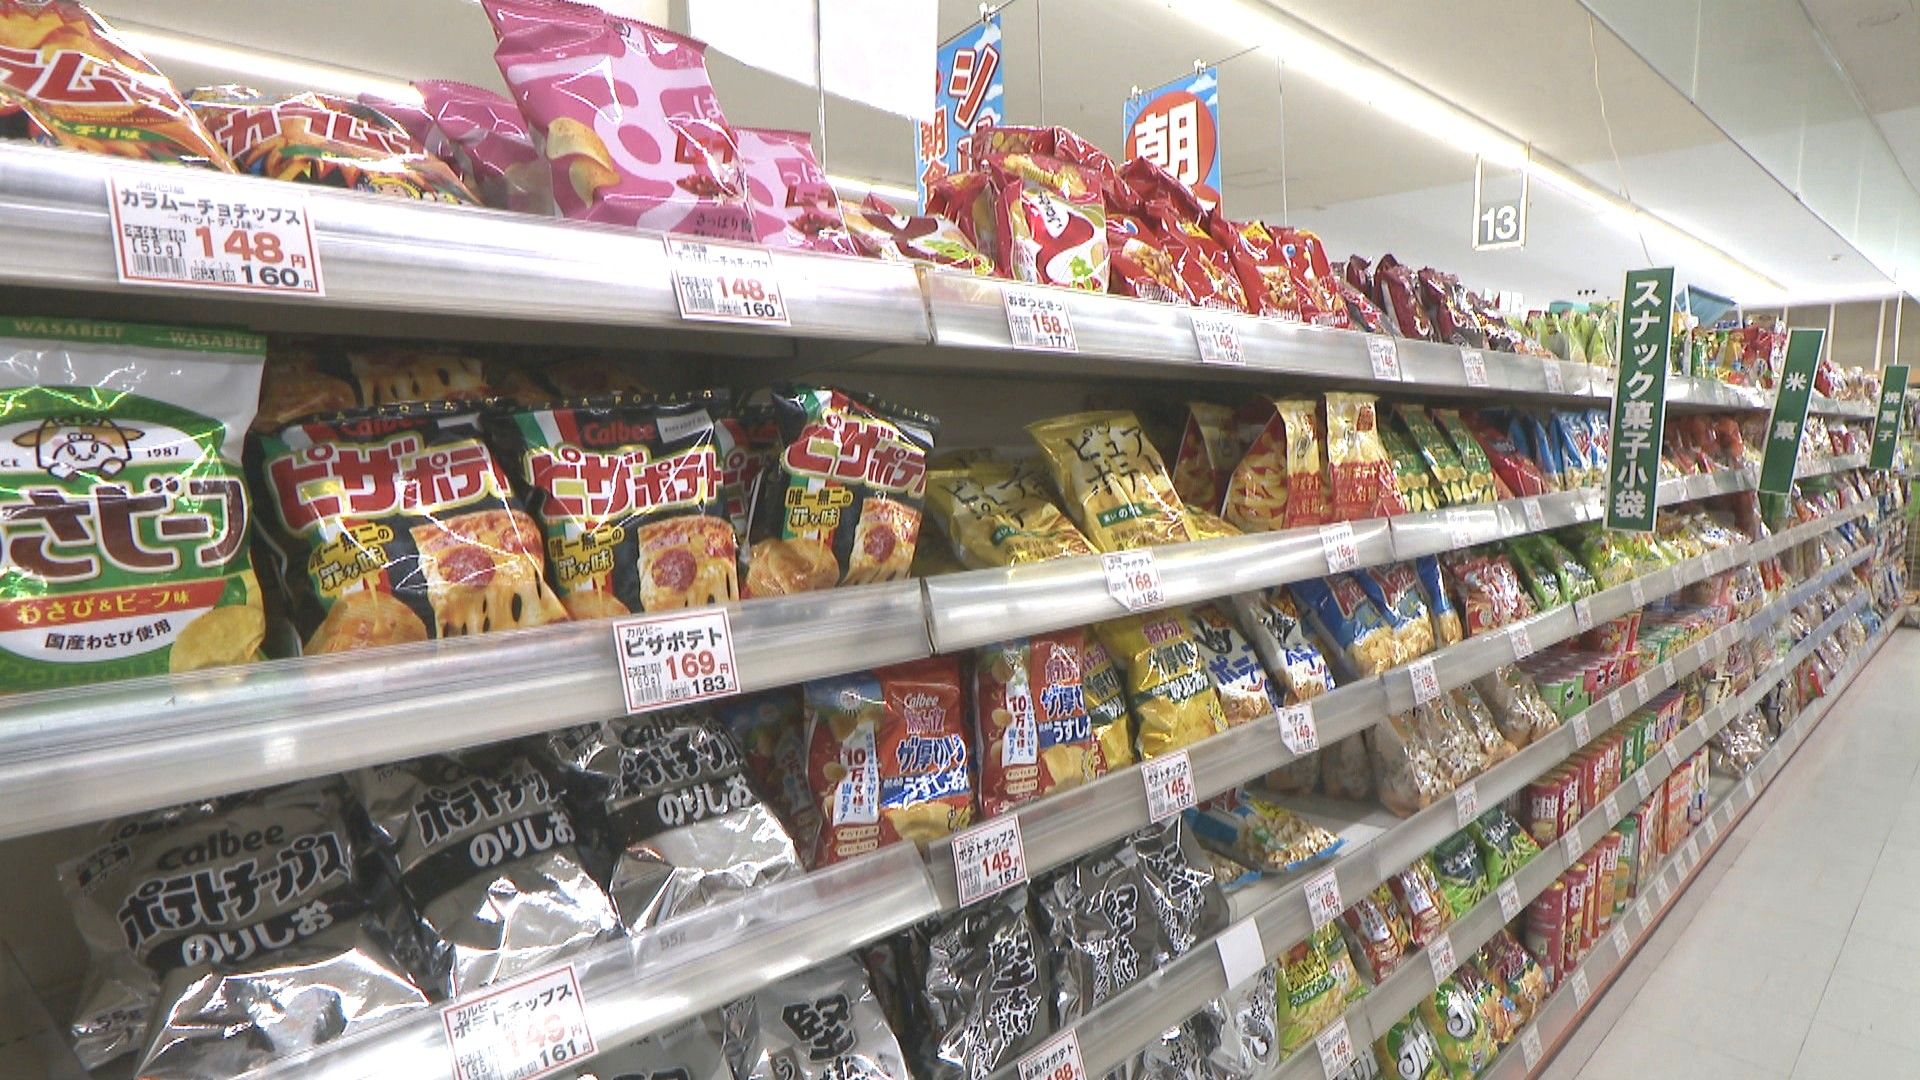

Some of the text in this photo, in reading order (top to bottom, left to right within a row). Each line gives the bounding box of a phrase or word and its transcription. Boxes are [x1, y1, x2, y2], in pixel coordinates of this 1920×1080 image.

[1133, 100, 1199, 187] 朝
[120, 187, 302, 225] カラムーチョチップス
[1481, 204, 1519, 242] 13
[195, 225, 285, 264] 148
[240, 264, 300, 288] 160
[716, 276, 766, 301] 148
[742, 301, 776, 318] 160
[1032, 312, 1063, 335] 158
[14, 320, 263, 350] WASABEEF WASABEEF
[1049, 334, 1068, 349] 171
[1213, 333, 1234, 350] 148
[1614, 278, 1663, 521] スナック菓子小袋
[584, 421, 657, 444] Calbee
[147, 446, 181, 459] 1987
[531, 446, 724, 518] ピザポテト
[787, 488, 852, 507] 唯一無二の
[0, 477, 247, 578] さビーフ
[1128, 572, 1153, 592] 168
[16, 590, 190, 625] わさび&ビーフ味
[1142, 590, 1159, 605] 182
[45, 618, 171, 651] 国産わさび使用
[625, 627, 722, 658] ピザポテト
[665, 650, 716, 681] 169
[692, 674, 727, 695] 183
[903, 693, 941, 709] Calbee
[657, 773, 753, 826] のりしお
[1165, 776, 1186, 799] 145
[1176, 793, 1191, 808] 157
[469, 810, 577, 869] のりしお
[959, 829, 1016, 861] ポテトチップス
[982, 848, 1012, 878] 145
[998, 867, 1019, 886] 157
[117, 831, 351, 950] ポテトチップス
[181, 900, 334, 967] のりしお
[539, 1040, 578, 1068] 161
[1047, 1062, 1073, 1080] 88
